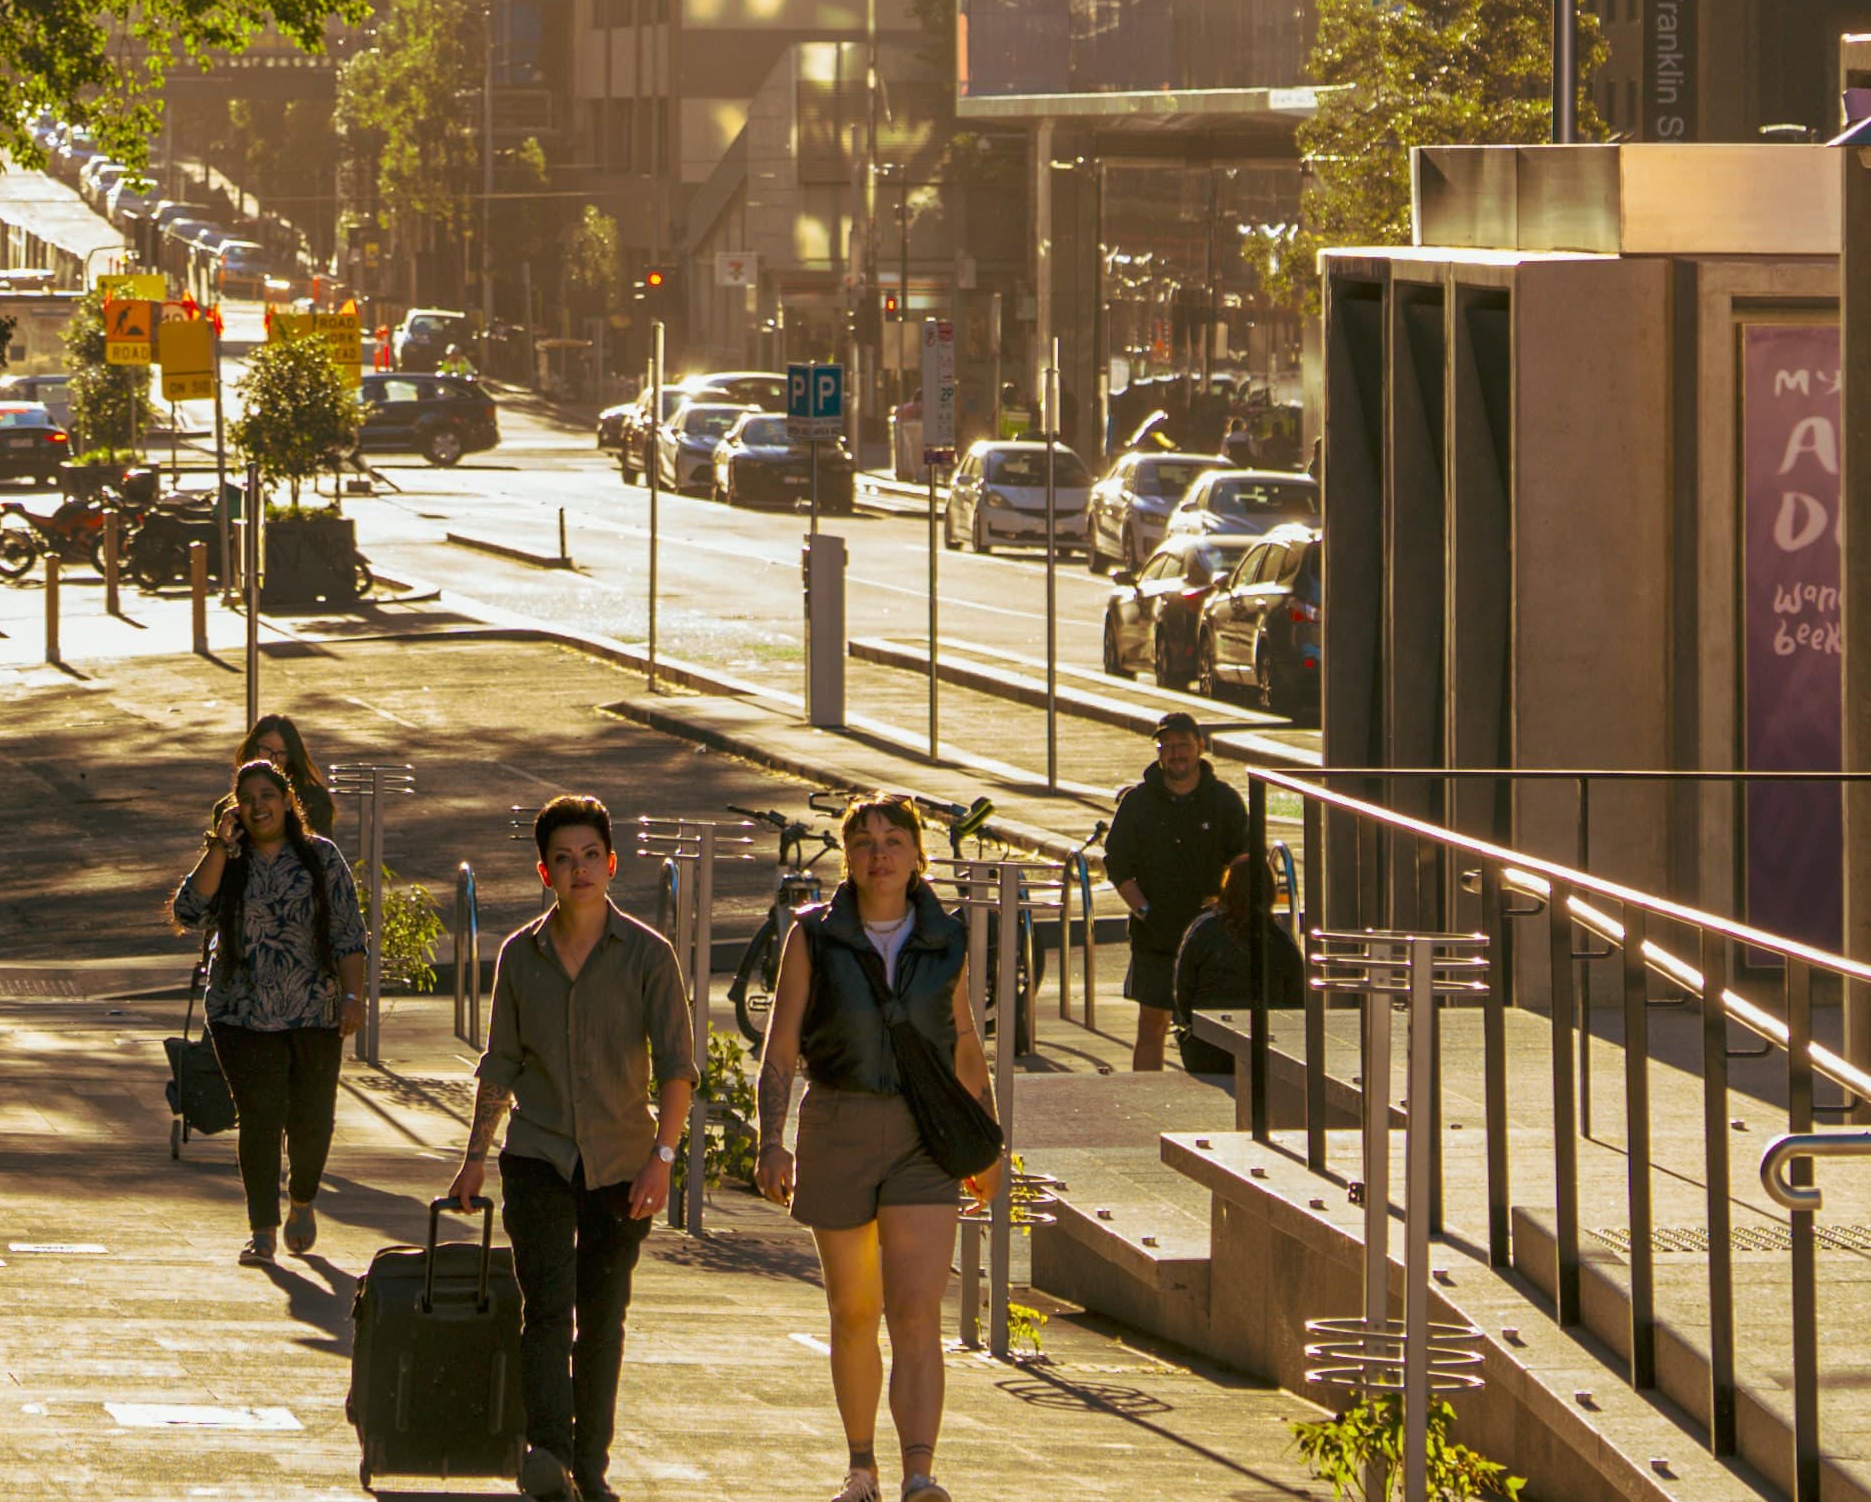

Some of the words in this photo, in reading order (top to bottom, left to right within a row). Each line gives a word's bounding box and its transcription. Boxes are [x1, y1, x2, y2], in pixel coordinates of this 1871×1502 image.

[1657, 115, 1684, 143] S
[319, 317, 356, 330] ROAD
[113, 346, 150, 361] ROAD
[792, 375, 805, 409] P
[818, 375, 835, 410] P
[940, 386, 955, 403] 2P
[1774, 491, 1841, 552] D
[1774, 582, 1841, 614] wan
